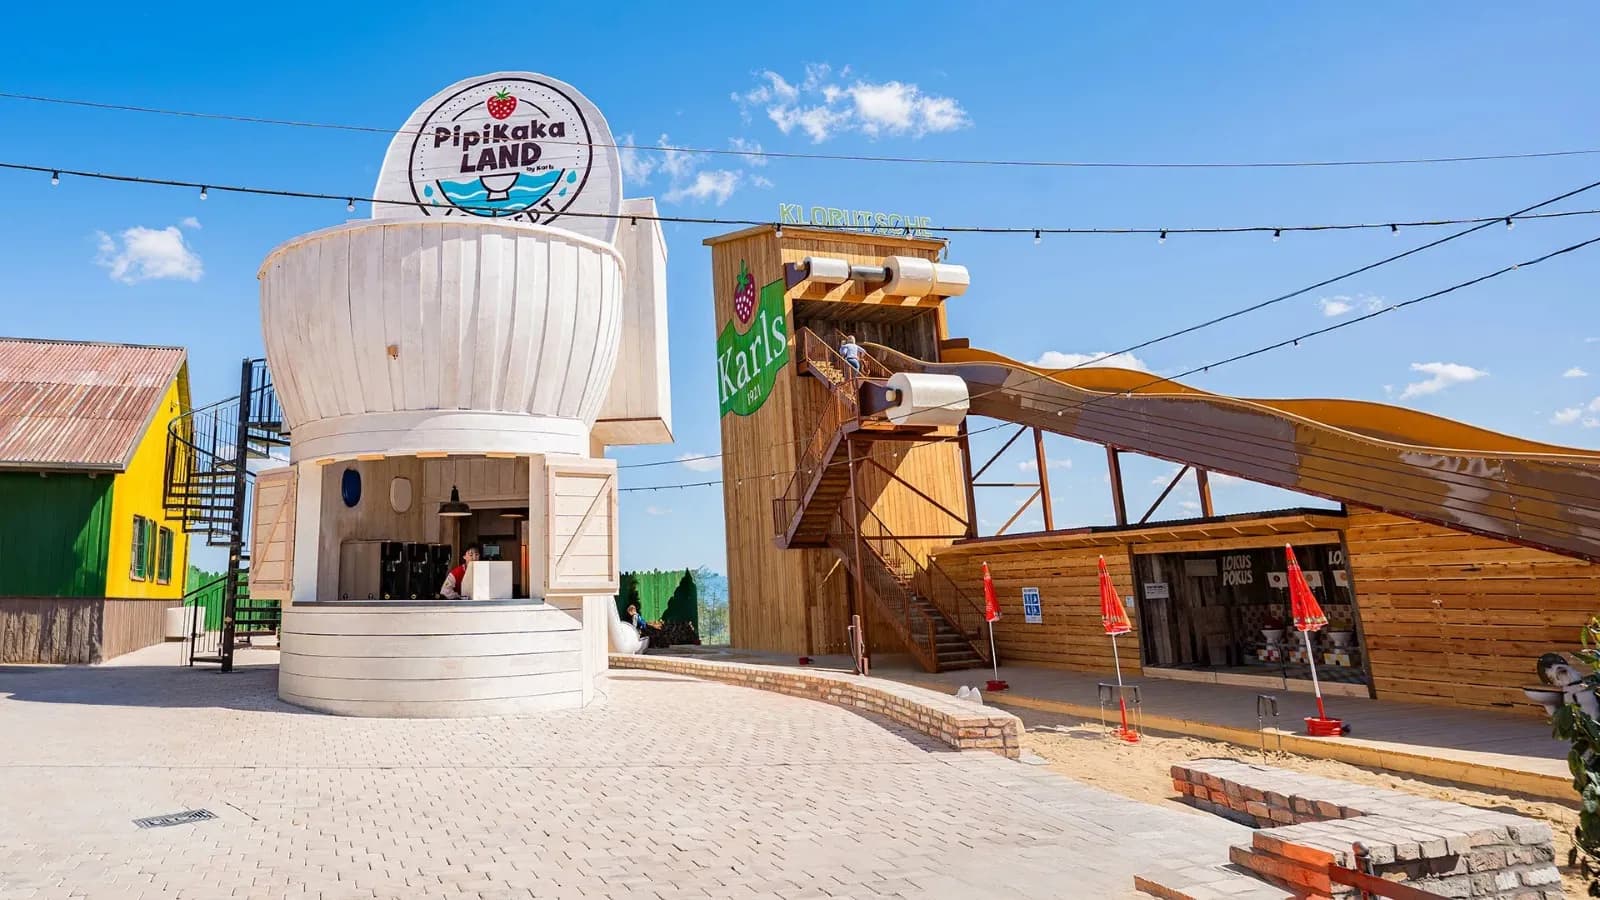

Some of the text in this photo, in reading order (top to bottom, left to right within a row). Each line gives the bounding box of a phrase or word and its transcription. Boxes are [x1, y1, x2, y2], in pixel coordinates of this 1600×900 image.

[434, 120, 565, 152] PipiKaka
[460, 142, 541, 173] LAND
[536, 163, 554, 171] Karls
[718, 309, 787, 405] Karls
[747, 384, 761, 405] 1921
[1222, 554, 1252, 570] LOKUS
[1328, 550, 1345, 565] LO
[1222, 569, 1253, 586] POKUS
